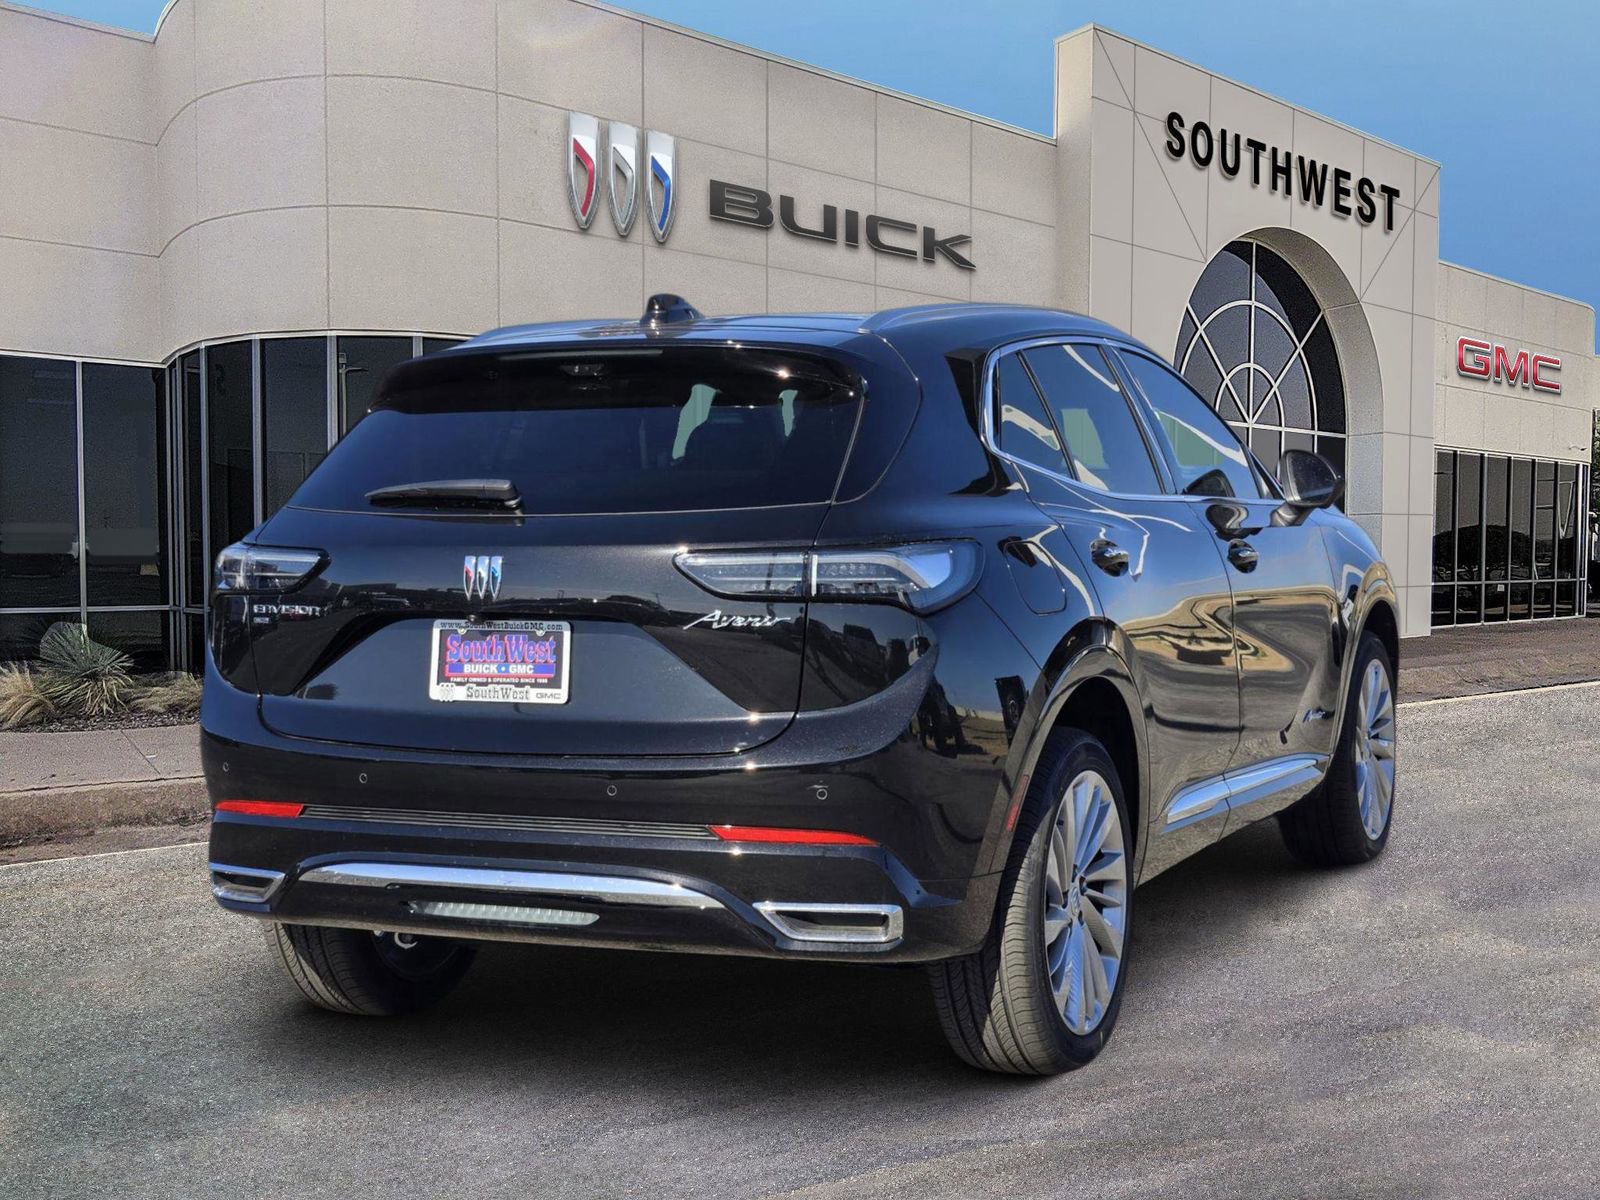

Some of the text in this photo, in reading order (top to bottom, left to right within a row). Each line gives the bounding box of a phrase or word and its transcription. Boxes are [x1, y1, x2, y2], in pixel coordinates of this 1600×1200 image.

[1166, 111, 1400, 232] SOUTHWEST
[709, 178, 977, 271] BUICK
[1457, 336, 1561, 395] GMC
[463, 663, 534, 674] BUICK GMC
